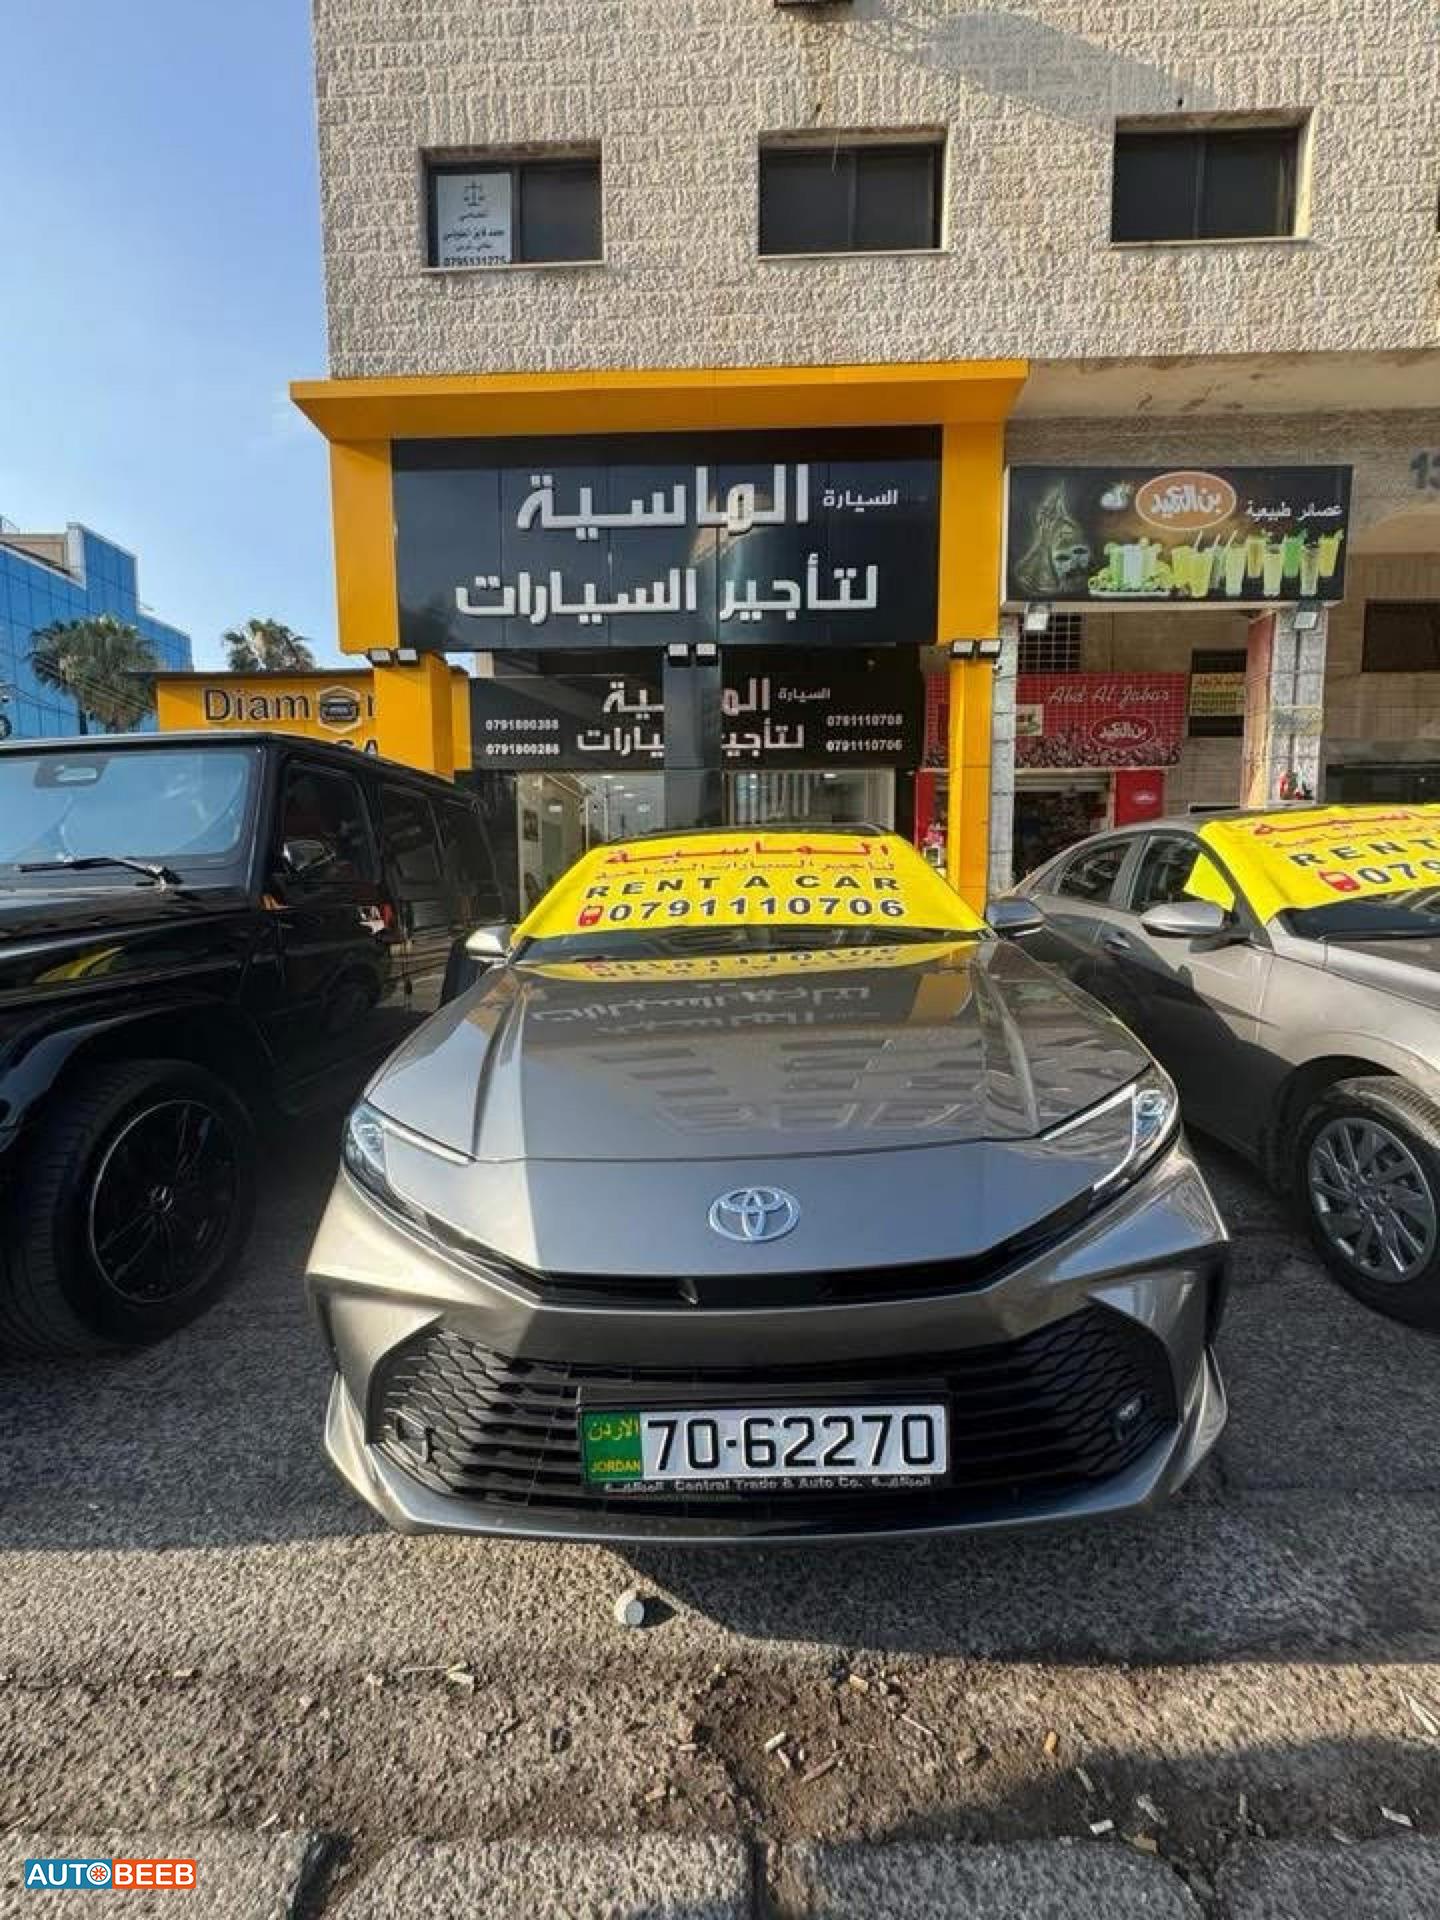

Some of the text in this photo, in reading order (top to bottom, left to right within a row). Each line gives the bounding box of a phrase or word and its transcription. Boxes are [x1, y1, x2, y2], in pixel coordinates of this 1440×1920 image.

[517, 464, 899, 540] السيارة الماسية
[455, 553, 879, 625] لتأجير السيارات
[777, 687, 831, 703] السيارة
[584, 874, 901, 900] RENT A CAR
[608, 897, 905, 922] 0791110706
[647, 1413, 936, 1472] 70-62270
[591, 1459, 641, 1473] JORDAN
[674, 1478, 730, 1492] Central
[735, 1476, 778, 1490] Trade
[783, 1476, 795, 1489] &
[799, 1476, 833, 1489] Auto
[839, 1475, 863, 1488] Co.
